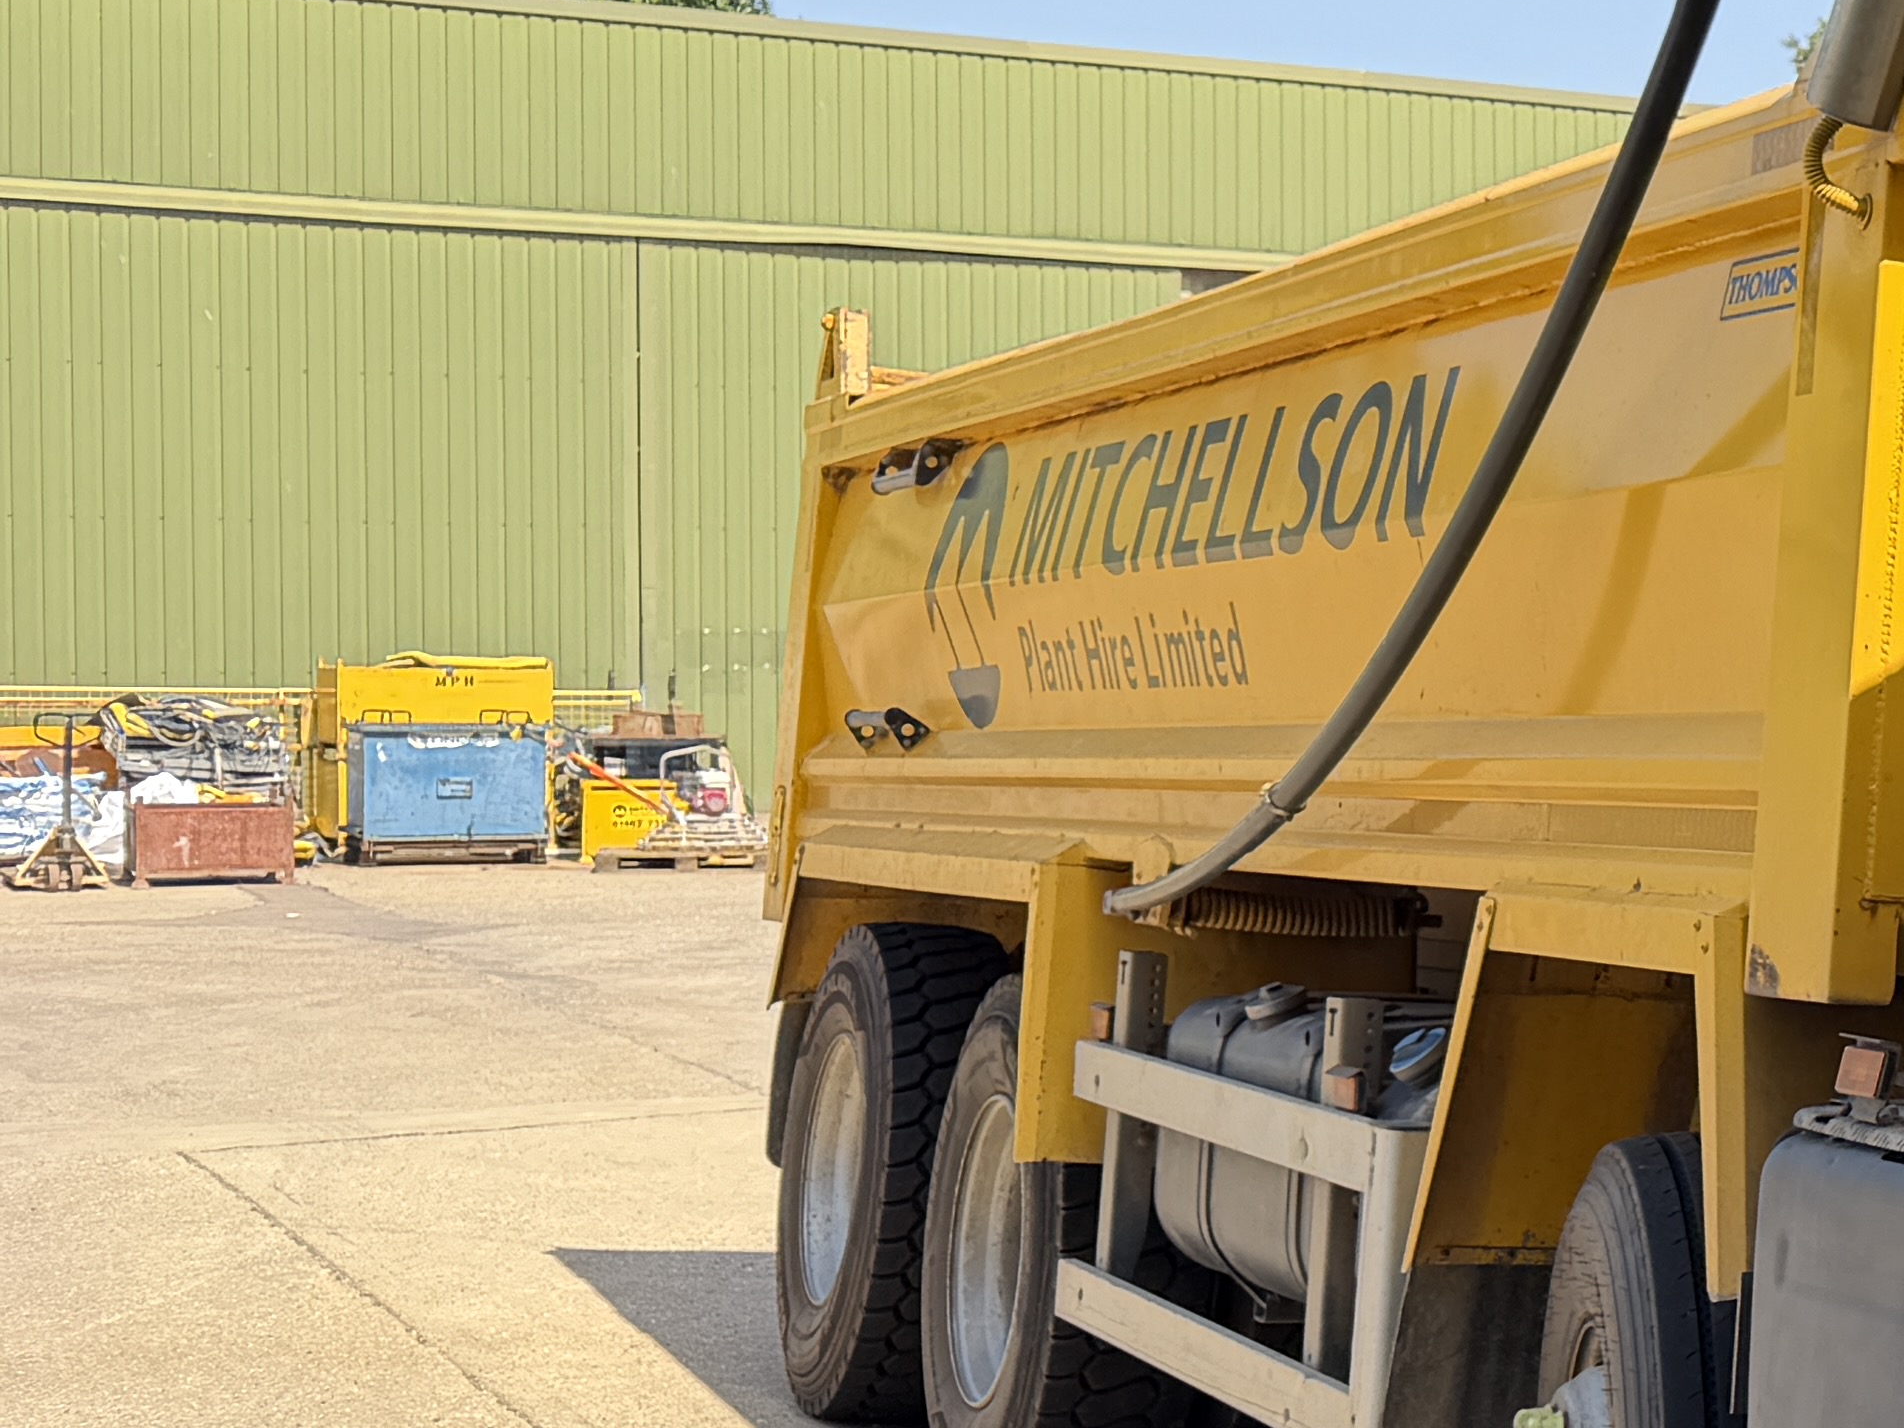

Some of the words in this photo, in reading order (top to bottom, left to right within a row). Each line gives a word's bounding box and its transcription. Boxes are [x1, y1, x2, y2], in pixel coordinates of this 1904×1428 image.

[1728, 263, 1797, 305] THOMPS
[1008, 366, 1461, 587] MITCHELLSON
[1017, 621, 1081, 698] Plant
[1084, 616, 1138, 693] Hire
[1141, 601, 1250, 690] Limited
